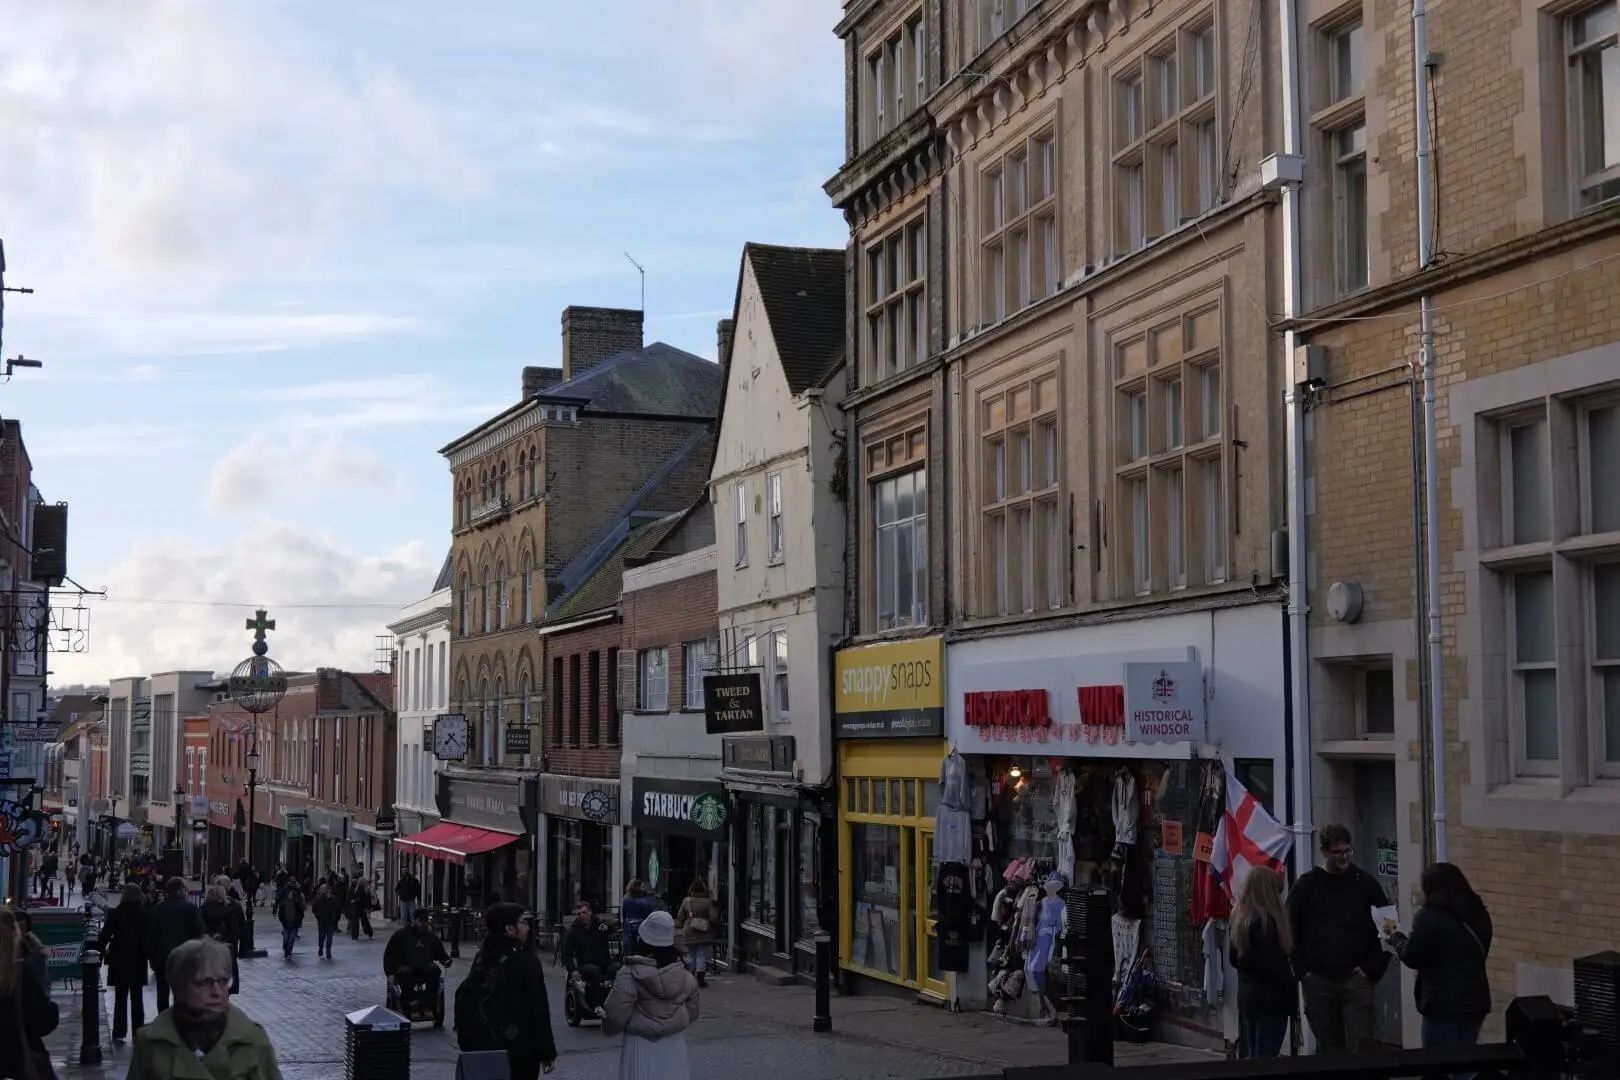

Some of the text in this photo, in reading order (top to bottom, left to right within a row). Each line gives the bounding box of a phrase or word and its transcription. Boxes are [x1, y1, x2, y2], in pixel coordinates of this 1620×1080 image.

[842, 660, 931, 704] snappy snaps
[714, 686, 751, 697] TWEED
[729, 698, 740, 709] &
[964, 685, 1125, 728] HISTORICAL WIND
[714, 709, 753, 721] TARTAN
[1134, 710, 1193, 722] HISTORICAL
[1139, 723, 1190, 735] WINDSOR
[643, 791, 695, 820] STARBUCK
